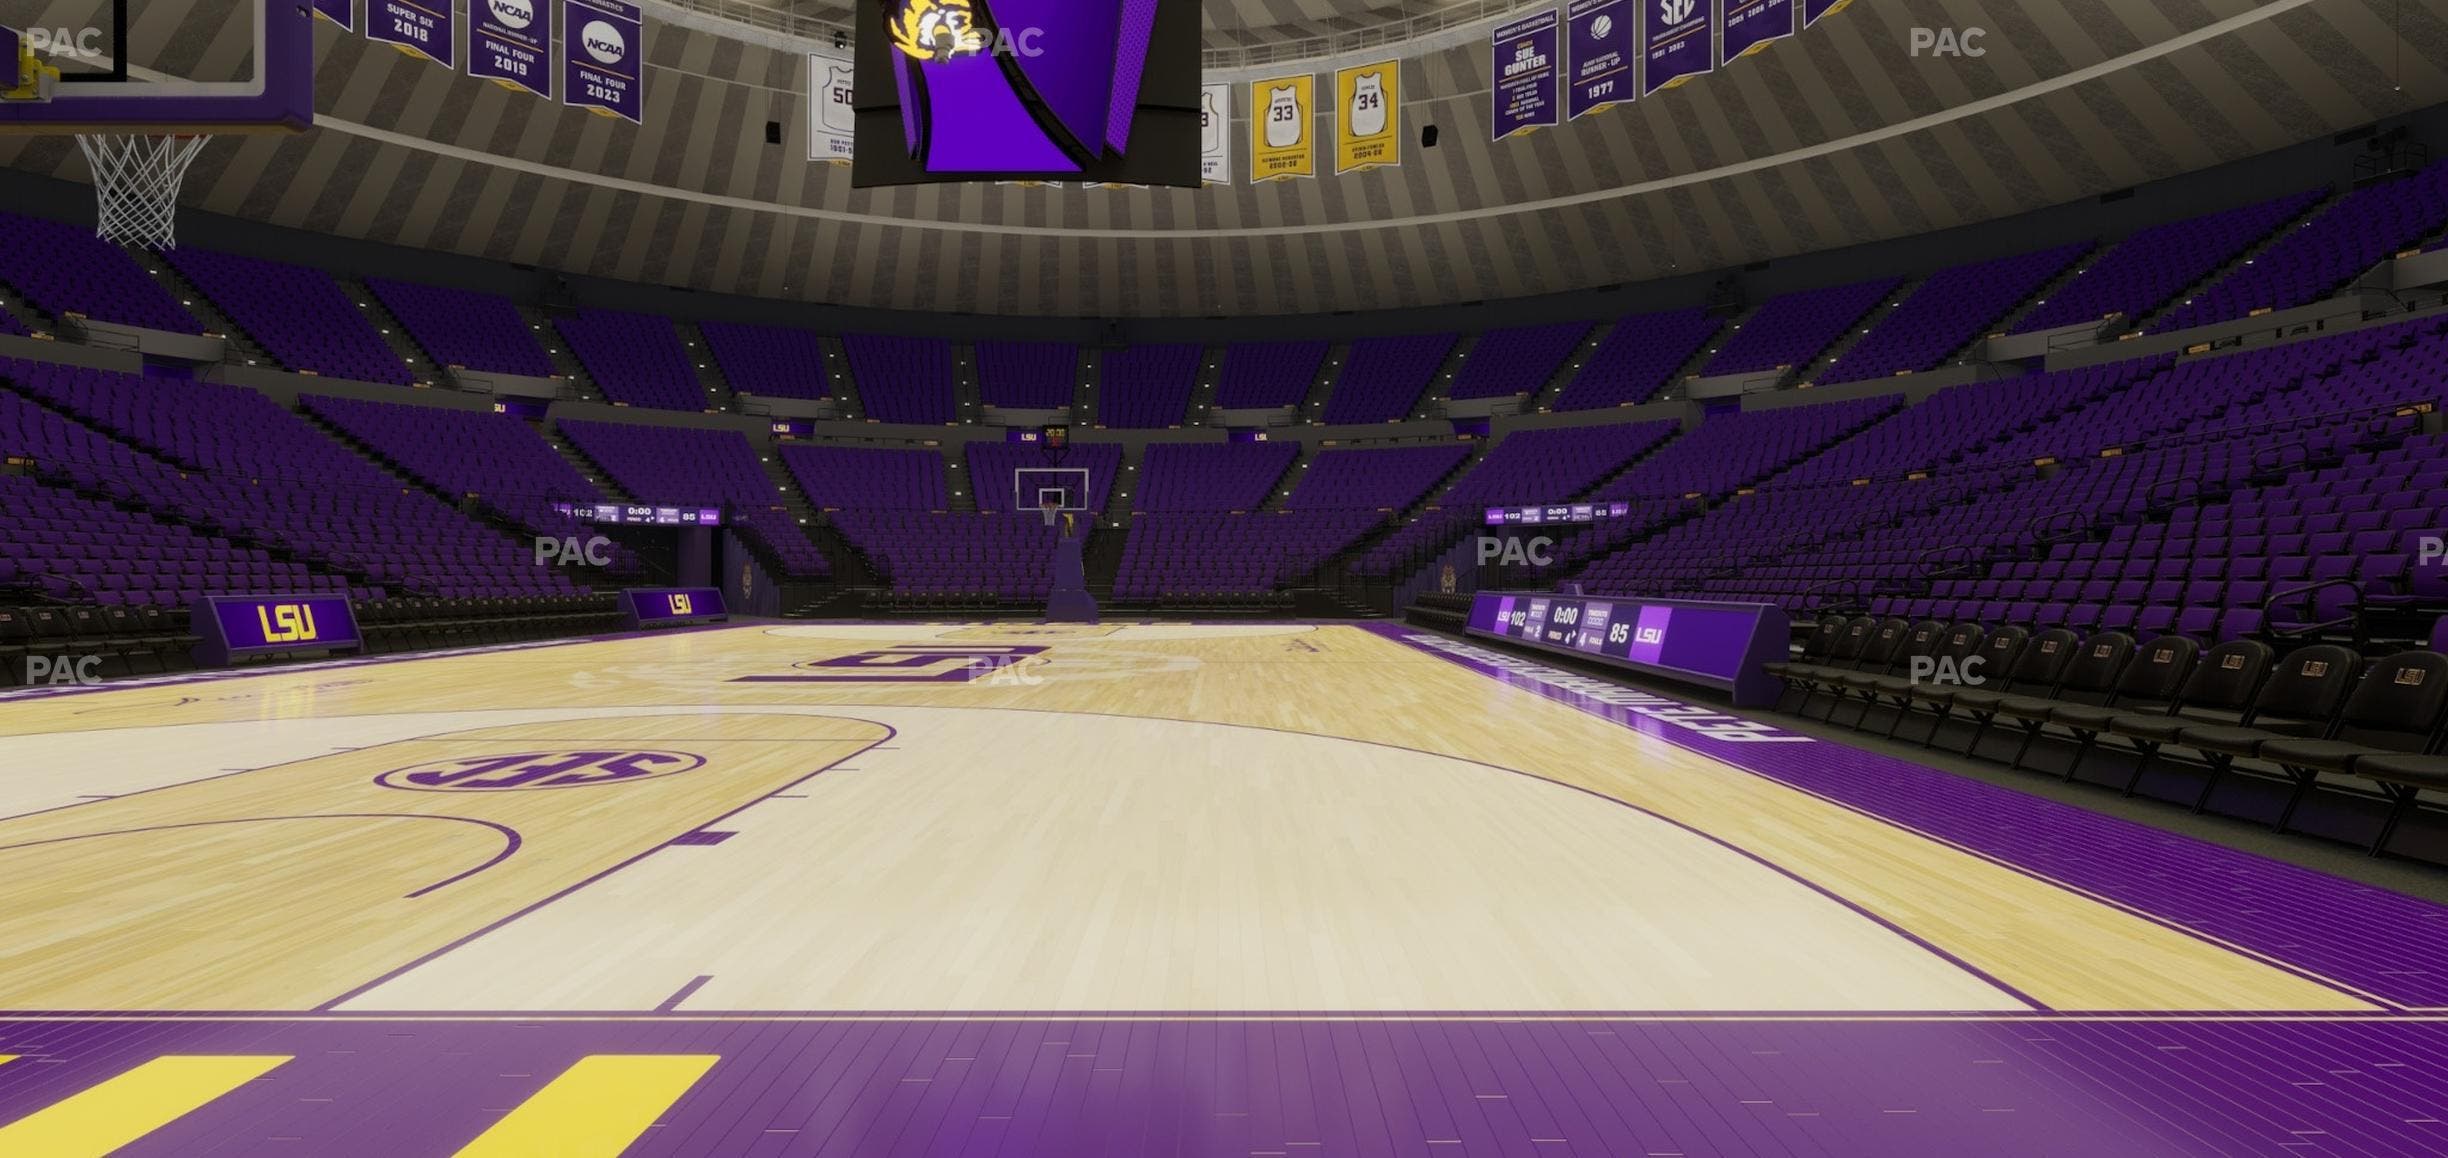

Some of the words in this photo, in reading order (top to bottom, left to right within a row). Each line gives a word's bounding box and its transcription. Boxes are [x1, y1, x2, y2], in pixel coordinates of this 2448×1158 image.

[387, 3, 417, 21] SUPER
[419, 15, 434, 29] SIX
[493, 2, 532, 22] NCAA
[394, 19, 429, 42] 2018
[486, 40, 510, 56] FINAL
[512, 48, 535, 64] FOUR
[587, 37, 624, 57] NCAA
[1515, 46, 1535, 62] SUE
[494, 55, 528, 76] 2019
[1504, 54, 1547, 76] GUNTER
[580, 70, 603, 84] FINAL
[605, 77, 627, 91] FOUR
[1588, 80, 1614, 99] 1977
[586, 84, 621, 104] 2023
[1358, 92, 1379, 111] 34
[1273, 105, 1293, 122] 33
[772, 423, 790, 433] LSU
[1021, 433, 1037, 441] LSU
[574, 508, 593, 517] 102
[628, 506, 652, 516] 0:00
[682, 513, 696, 521] 85
[1504, 512, 1521, 520] 102
[1547, 507, 1568, 515] 0:00
[668, 593, 693, 615] LSU
[257, 604, 319, 643] LSU
[1497, 610, 1511, 622] LSU
[1510, 610, 1526, 627] 102
[1553, 606, 1579, 625] 0:00
[1609, 622, 1630, 644] 85
[1635, 627, 1663, 644] LSU
[1534, 625, 1542, 638] 2
[1564, 632, 1571, 645] 4
[1579, 632, 1588, 647] 4
[2093, 643, 2113, 659] LSU
[2153, 648, 2174, 664] LSU
[2220, 654, 2246, 670] LSU
[2300, 660, 2329, 678] LSU
[2393, 667, 2426, 686] LSU
[1626, 706, 1818, 742] PETE
